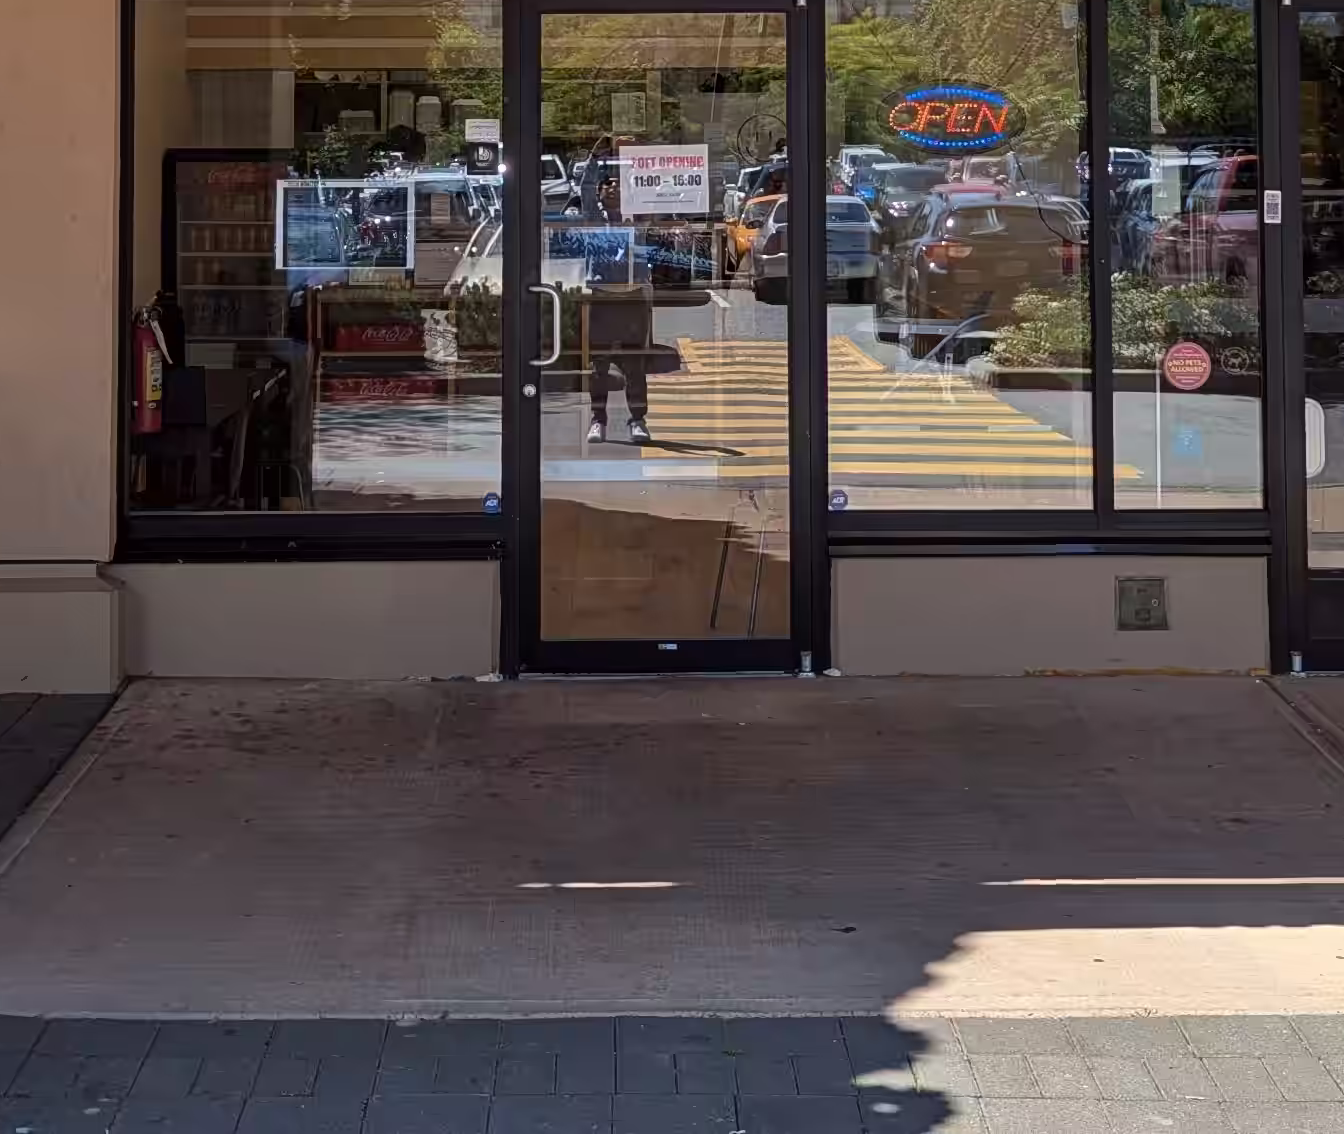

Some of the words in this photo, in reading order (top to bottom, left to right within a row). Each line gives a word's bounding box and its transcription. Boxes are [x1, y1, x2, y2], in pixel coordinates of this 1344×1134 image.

[889, 101, 1009, 133] OPEN
[659, 155, 704, 168] OPENING
[634, 175, 661, 187] 11:00
